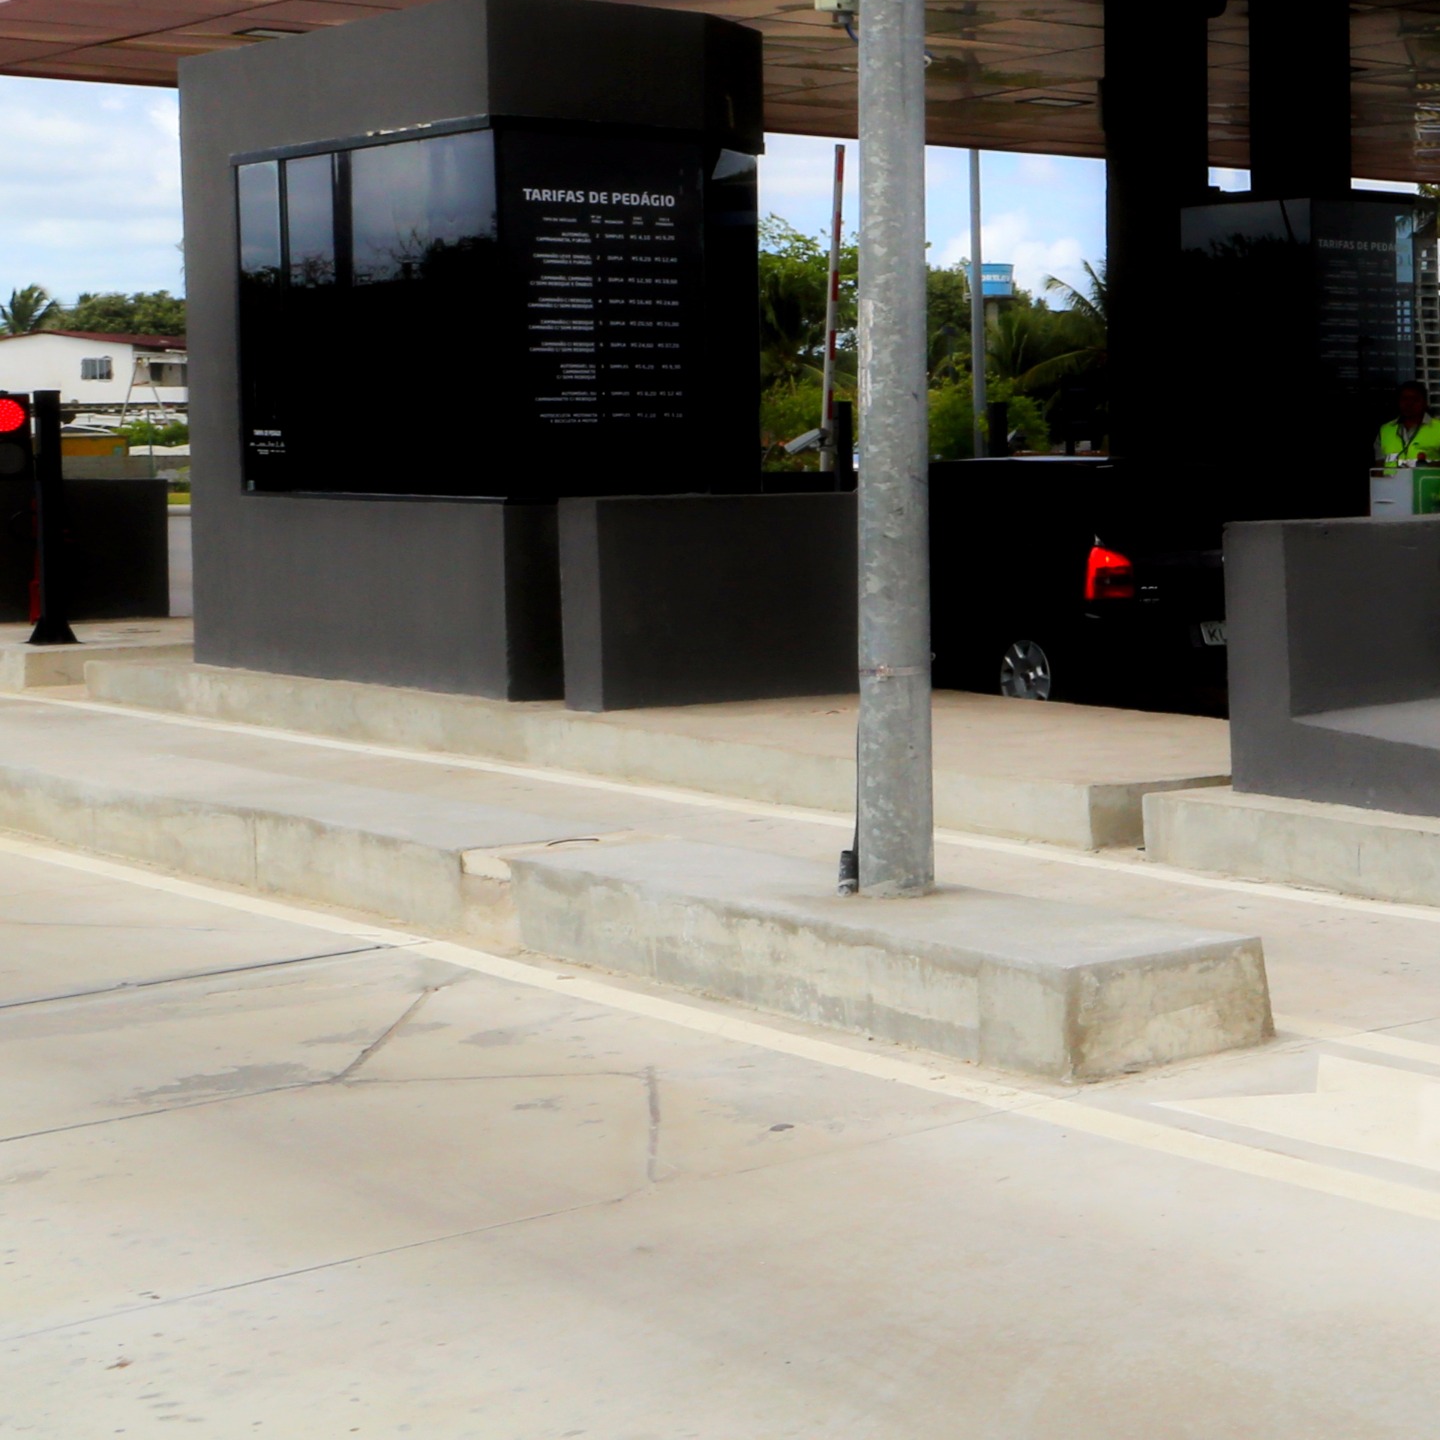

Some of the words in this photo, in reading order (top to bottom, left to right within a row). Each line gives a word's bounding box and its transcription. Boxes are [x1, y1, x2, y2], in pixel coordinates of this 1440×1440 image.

[522, 188, 585, 203] TARIFAS
[588, 191, 609, 204] DE
[611, 191, 676, 207] PEDÁGIO
